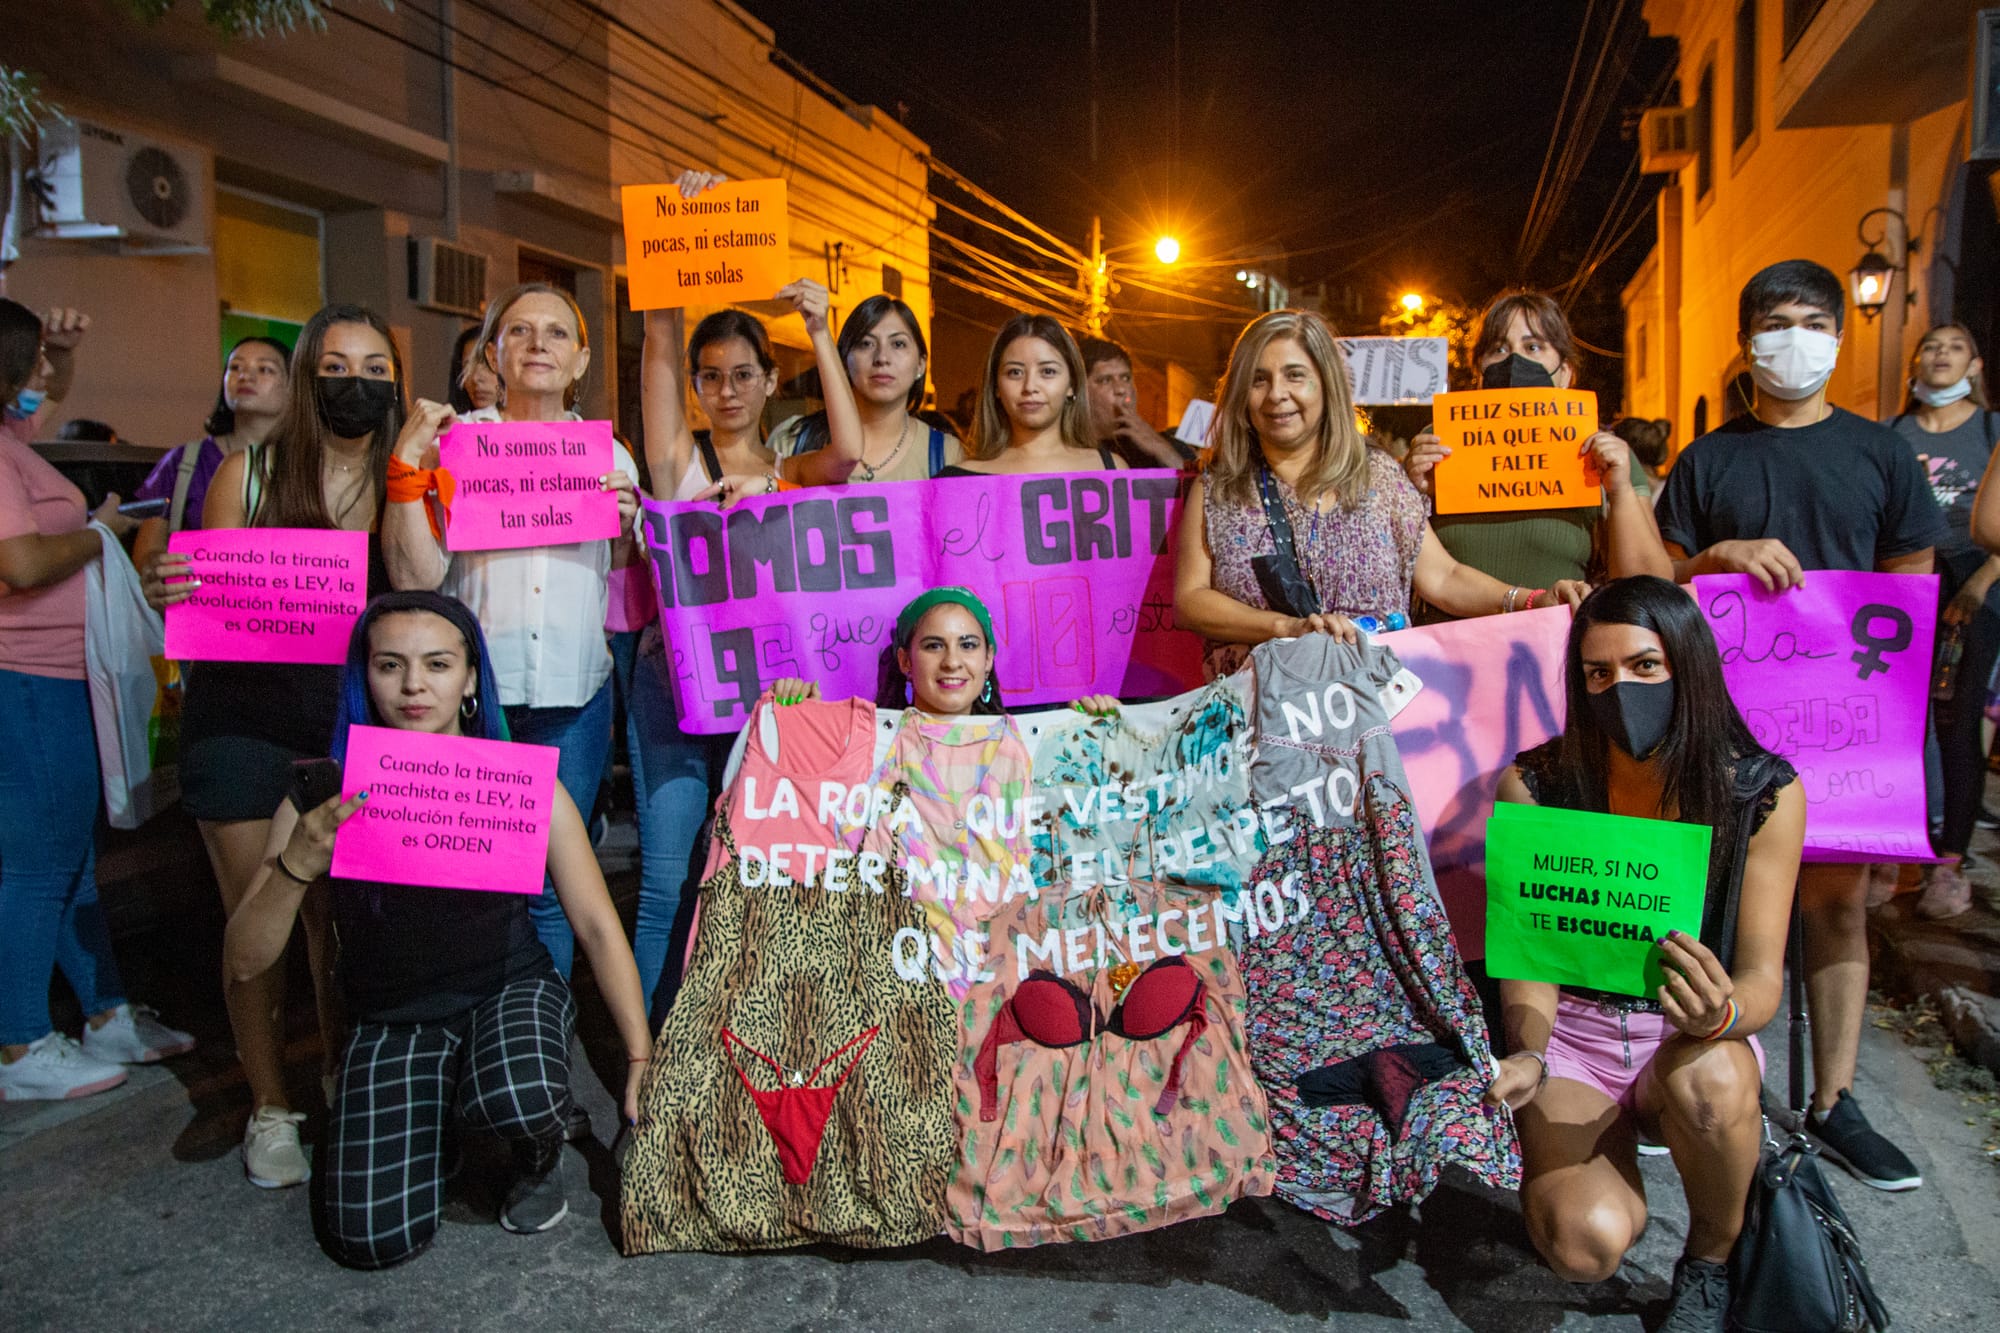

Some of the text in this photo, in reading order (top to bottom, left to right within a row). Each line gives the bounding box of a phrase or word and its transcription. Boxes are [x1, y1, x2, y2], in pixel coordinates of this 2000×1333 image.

[656, 195, 759, 217] No somos tan
[642, 229, 776, 258] pocas, ni estamos
[678, 261, 743, 287] tan solas
[1450, 398, 1589, 421] FELIZ SERÁ EL
[477, 434, 586, 457] No somos tan
[1463, 426, 1577, 447] DÍA QUE NO
[1492, 453, 1549, 472] FALTE
[462, 476, 515, 497] pocas,
[520, 471, 534, 492] ni
[1478, 480, 1564, 499] NINGUNA
[501, 505, 573, 529] tan solas
[939, 491, 1004, 561] el
[1021, 477, 1193, 566] GRIT
[193, 548, 349, 569] Cuando la tiranía
[272, 577, 289, 588] es
[295, 576, 333, 593] LEY,
[339, 578, 354, 592] la
[279, 597, 358, 616] feminista
[225, 618, 315, 635] es ORDEN
[808, 613, 885, 671] que
[1746, 695, 1880, 757] DEUDA
[379, 754, 533, 786] Cuando la tiranía
[743, 776, 800, 820] LA
[966, 793, 1045, 839] QUE
[1281, 682, 1357, 744] NO
[369, 781, 535, 810] machista es LEY, la
[361, 805, 537, 834] revolución feminista
[1071, 849, 1129, 891] EL
[1156, 767, 1359, 872] RESPETO
[402, 833, 493, 854] es ORDEN
[1533, 854, 1659, 881] MUJER, SI NO
[1519, 882, 1671, 913] LUCHAS NADIE
[892, 870, 1310, 983] QUE MERECEMOS
[1530, 913, 1655, 943] TE ESCUCHA
